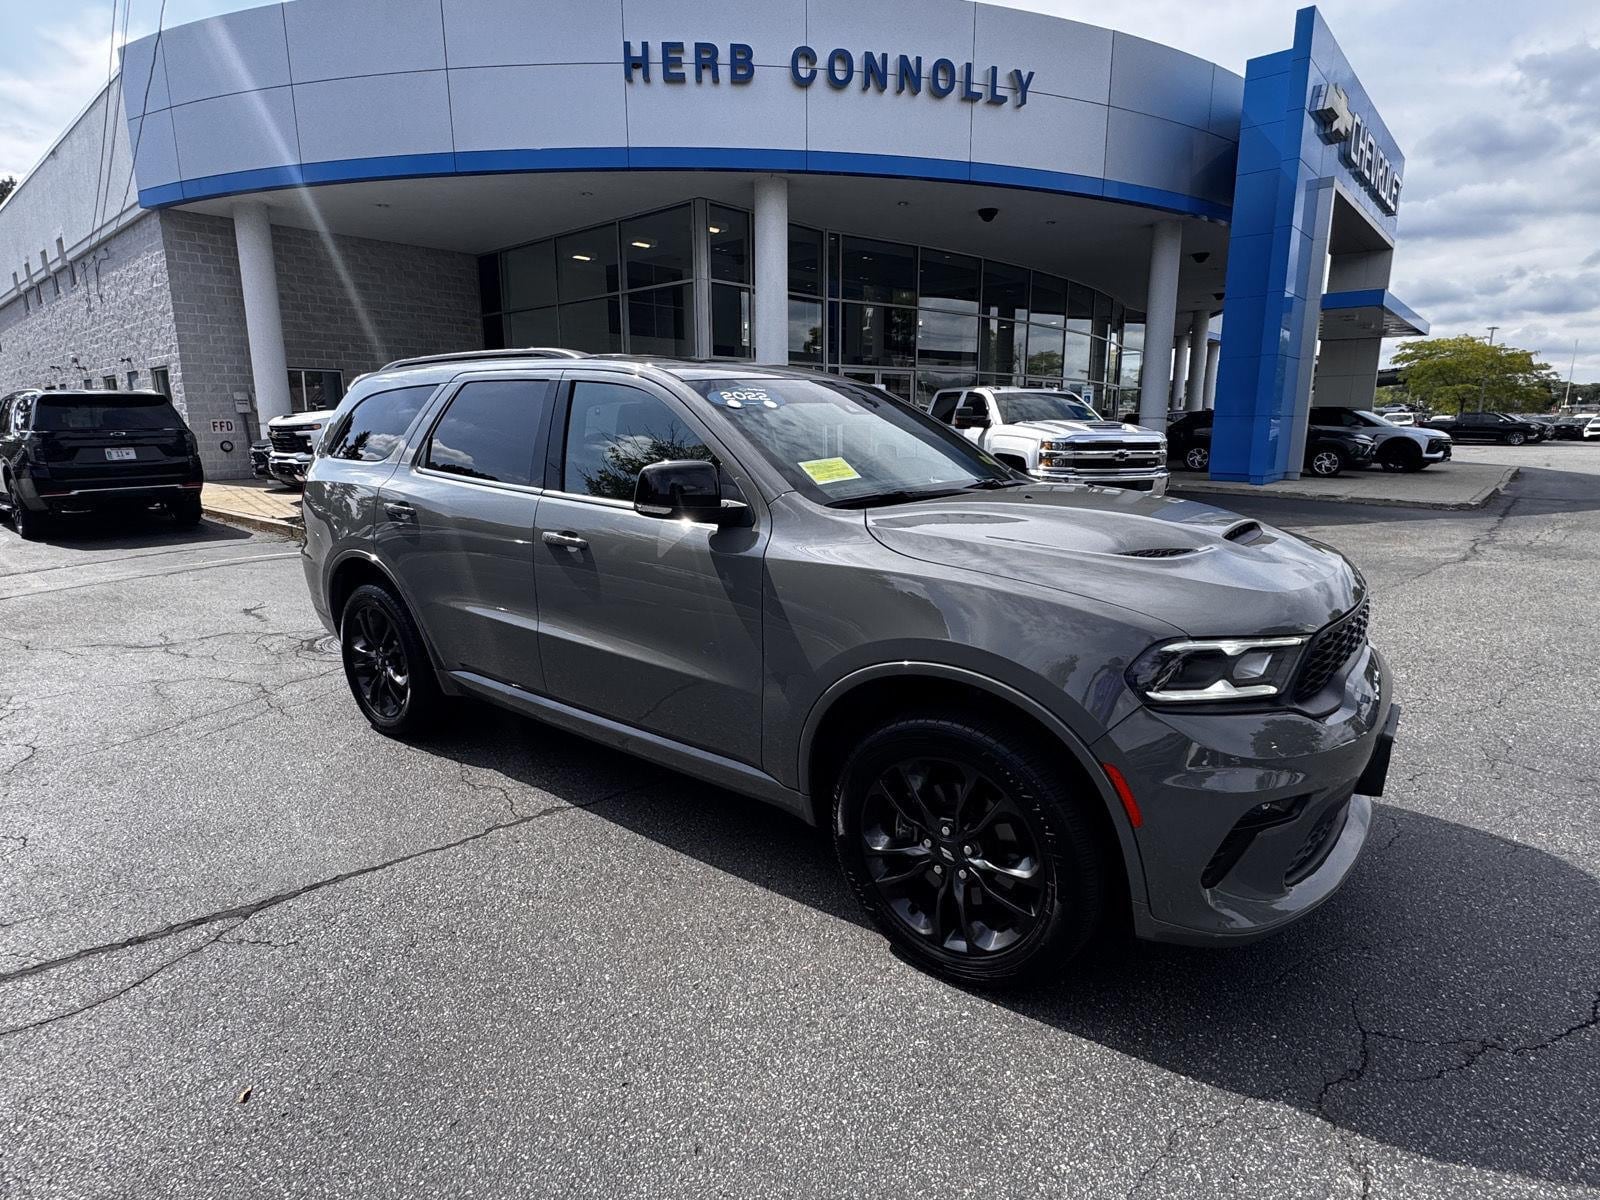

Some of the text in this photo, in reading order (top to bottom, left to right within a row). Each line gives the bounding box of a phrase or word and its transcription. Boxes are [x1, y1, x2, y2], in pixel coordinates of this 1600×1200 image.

[624, 41, 1034, 107] HERB CONNOLLY
[1350, 112, 1402, 213] CHEVROLET
[720, 391, 771, 401] 2022
[212, 421, 233, 432] FFD
